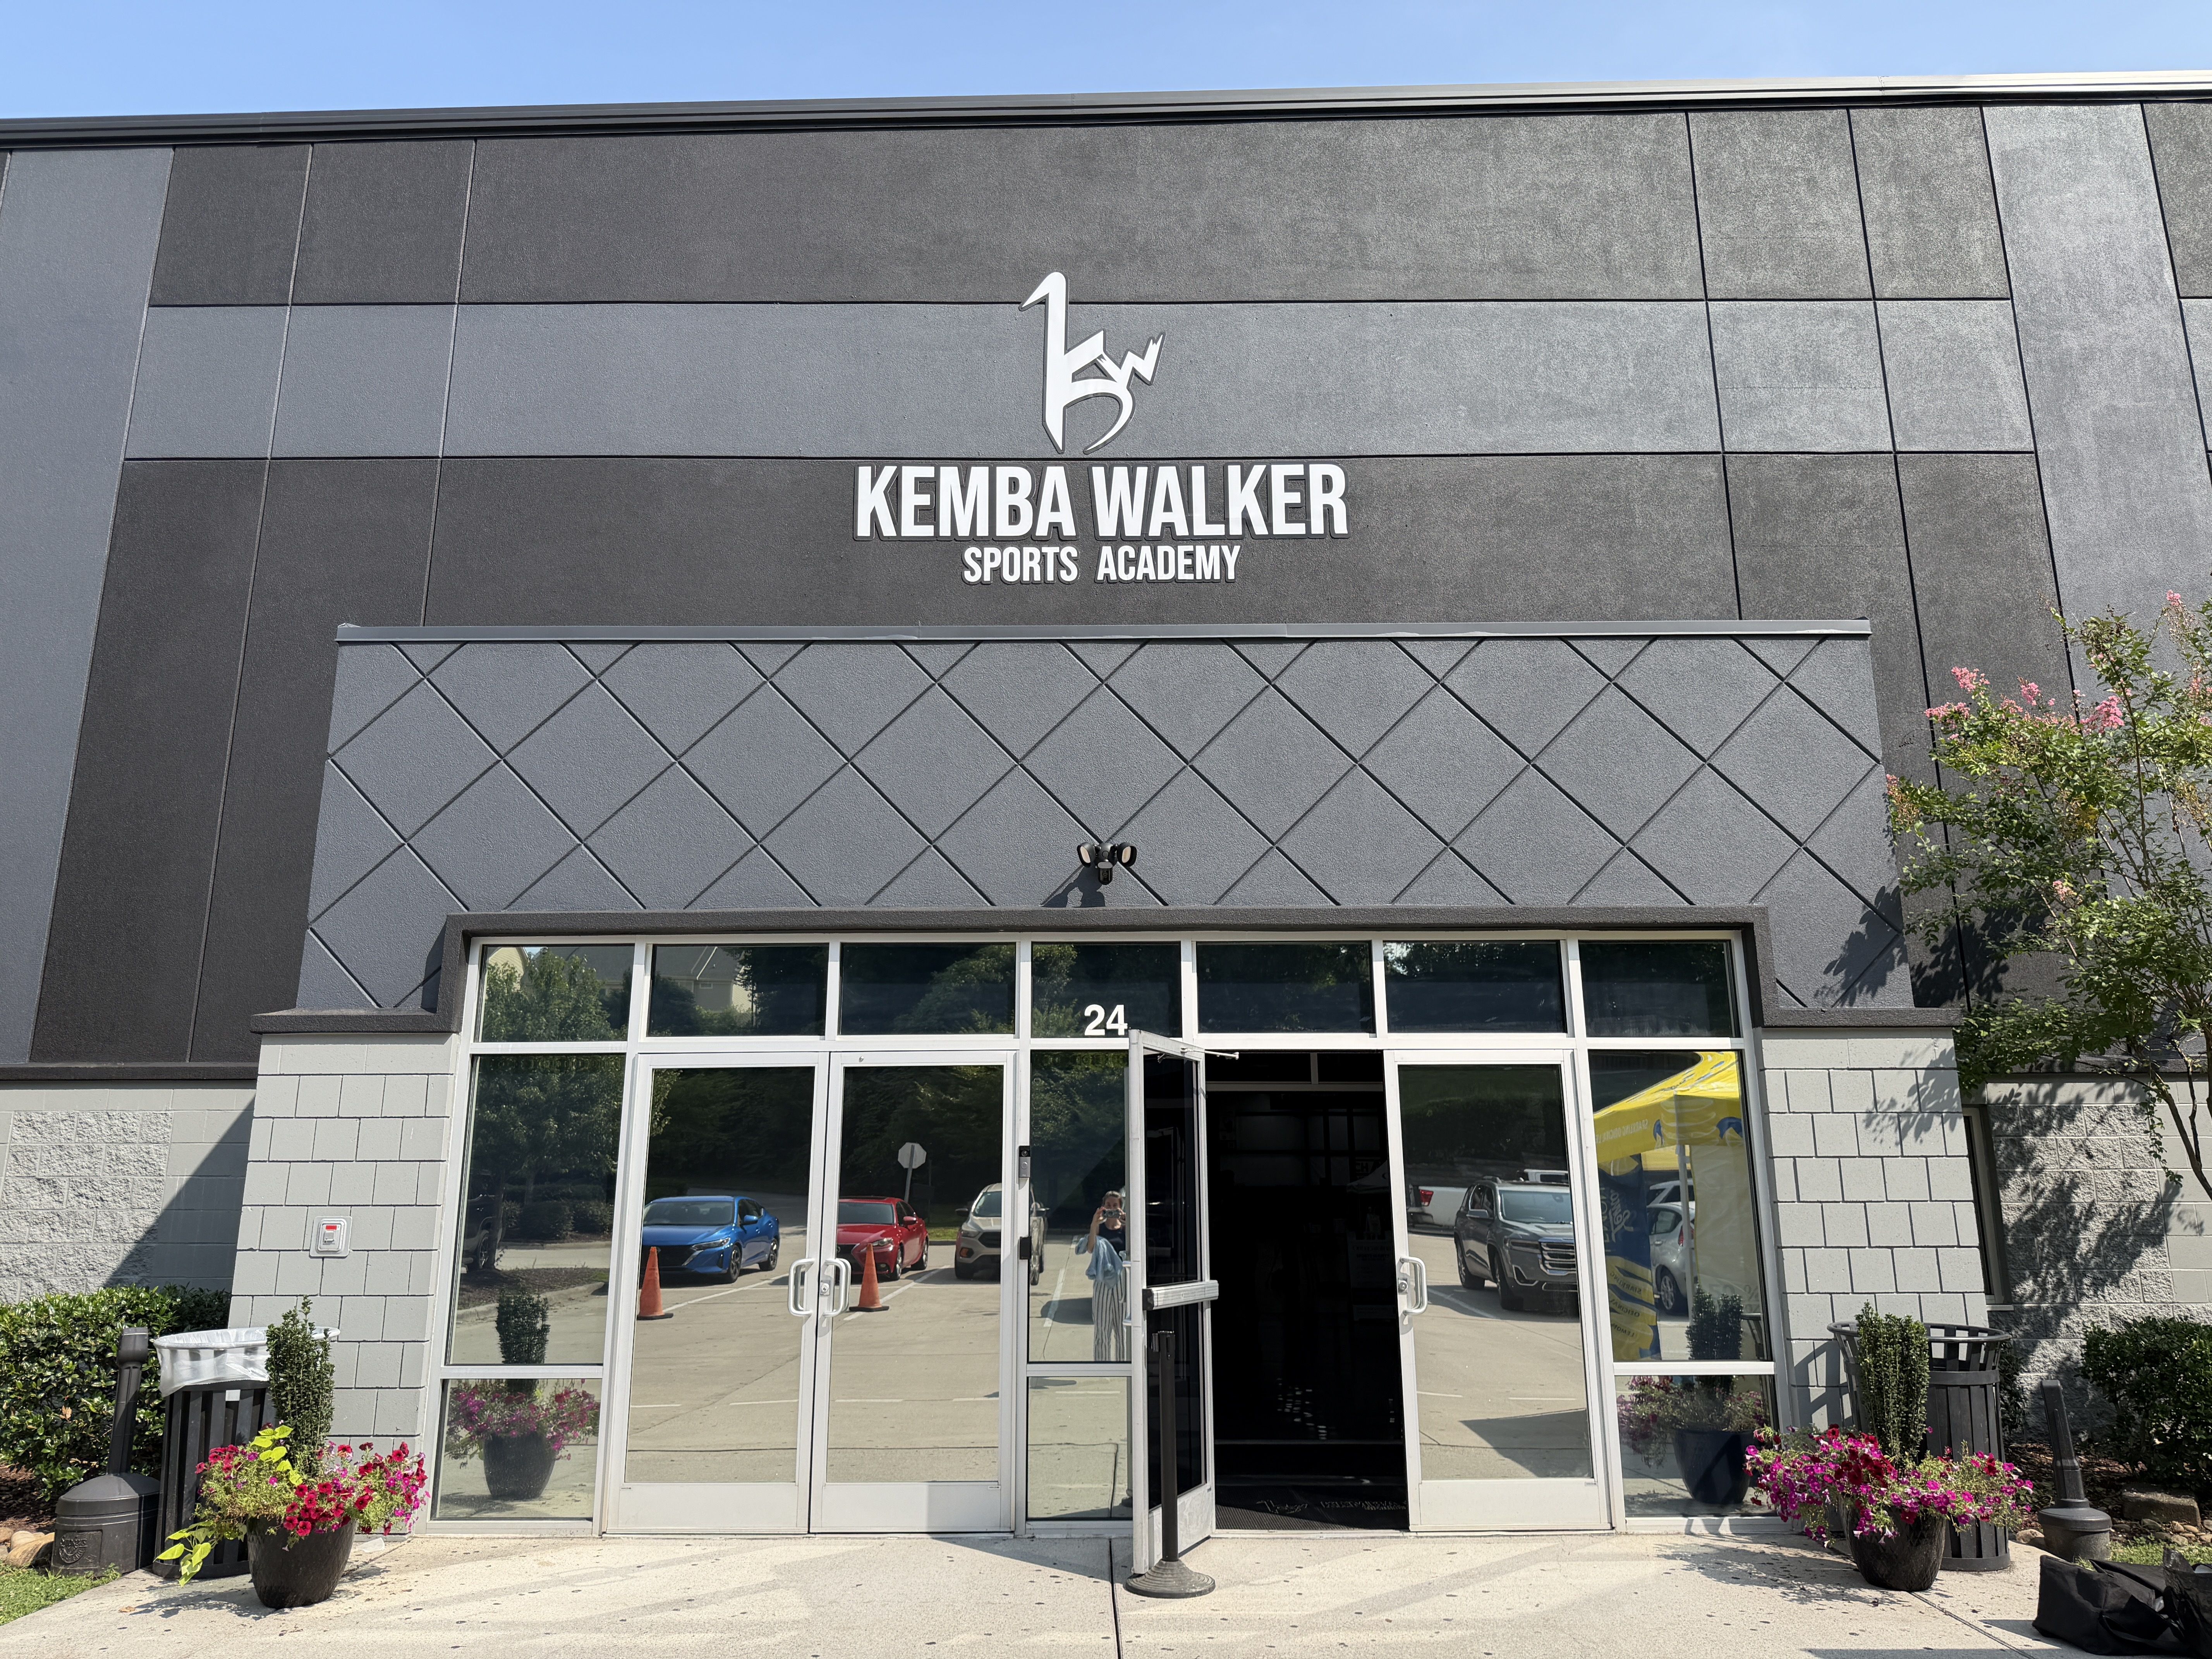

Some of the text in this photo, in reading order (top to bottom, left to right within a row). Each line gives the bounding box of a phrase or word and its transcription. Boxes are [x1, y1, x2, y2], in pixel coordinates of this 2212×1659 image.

[857, 464, 1349, 537] KEMBA WALKER
[963, 545, 1241, 583] SPORTS ACADEMY
[1084, 1004, 1128, 1036] 24
